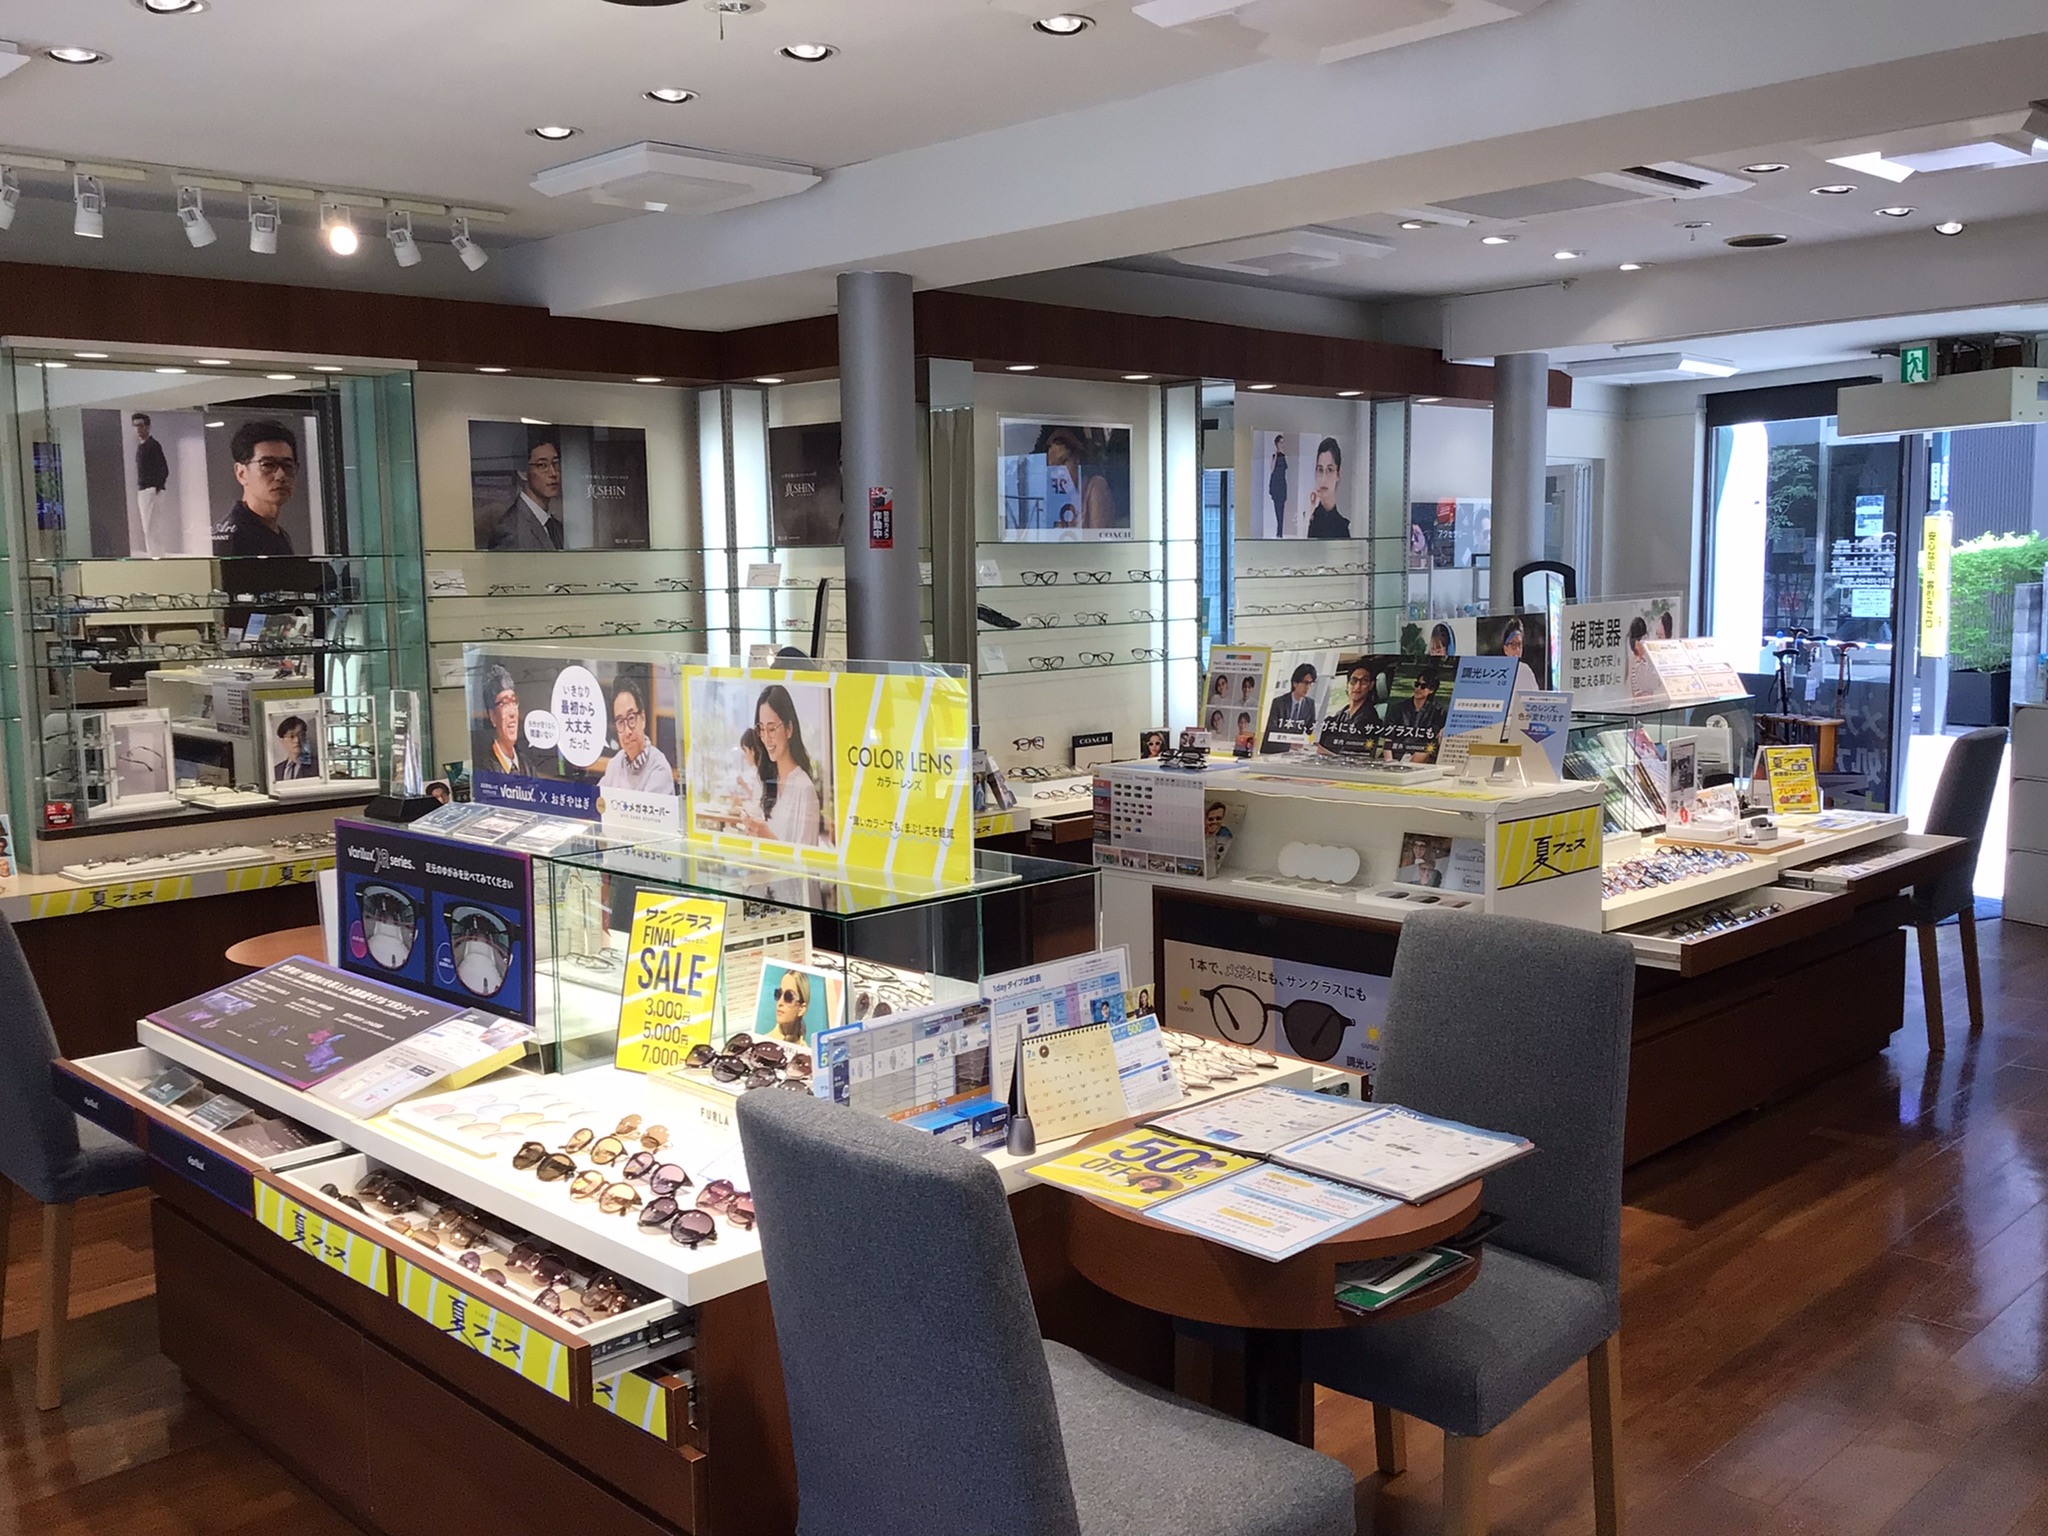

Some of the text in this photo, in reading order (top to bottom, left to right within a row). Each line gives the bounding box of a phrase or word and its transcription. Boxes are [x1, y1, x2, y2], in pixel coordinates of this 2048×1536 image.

[873, 511, 882, 539] 作動中
[1570, 618, 1621, 651] 補聴器
[1461, 667, 1509, 679] 調光レンズ
[563, 685, 590, 698] いきなり
[561, 700, 595, 717] 最初から
[1518, 713, 1565, 722] 色が変わります
[565, 718, 592, 734] 大丈夫
[1277, 718, 1435, 739] 1本で、メガネにも、サングラスにも
[569, 737, 590, 750] だった
[1079, 735, 1109, 745] COACH
[848, 746, 953, 775] COLOR LENS
[877, 776, 922, 791] カラーレンズ
[551, 793, 590, 810] おぎやはぎ
[629, 801, 671, 816] メガネスーパー
[1515, 836, 1586, 885] 夏フェス
[82, 889, 153, 913] 夏フェス
[646, 908, 712, 930] サングラス
[643, 925, 677, 948] FINAL
[638, 947, 706, 997] SALE
[1190, 958, 1366, 1001] 1本で、メガネにも、サングラスにも
[700, 1107, 729, 1127] FURLA
[1080, 1158, 1142, 1177] OFF
[289, 1210, 347, 1263] 夏フェス
[442, 1294, 520, 1360] 夏フェス
